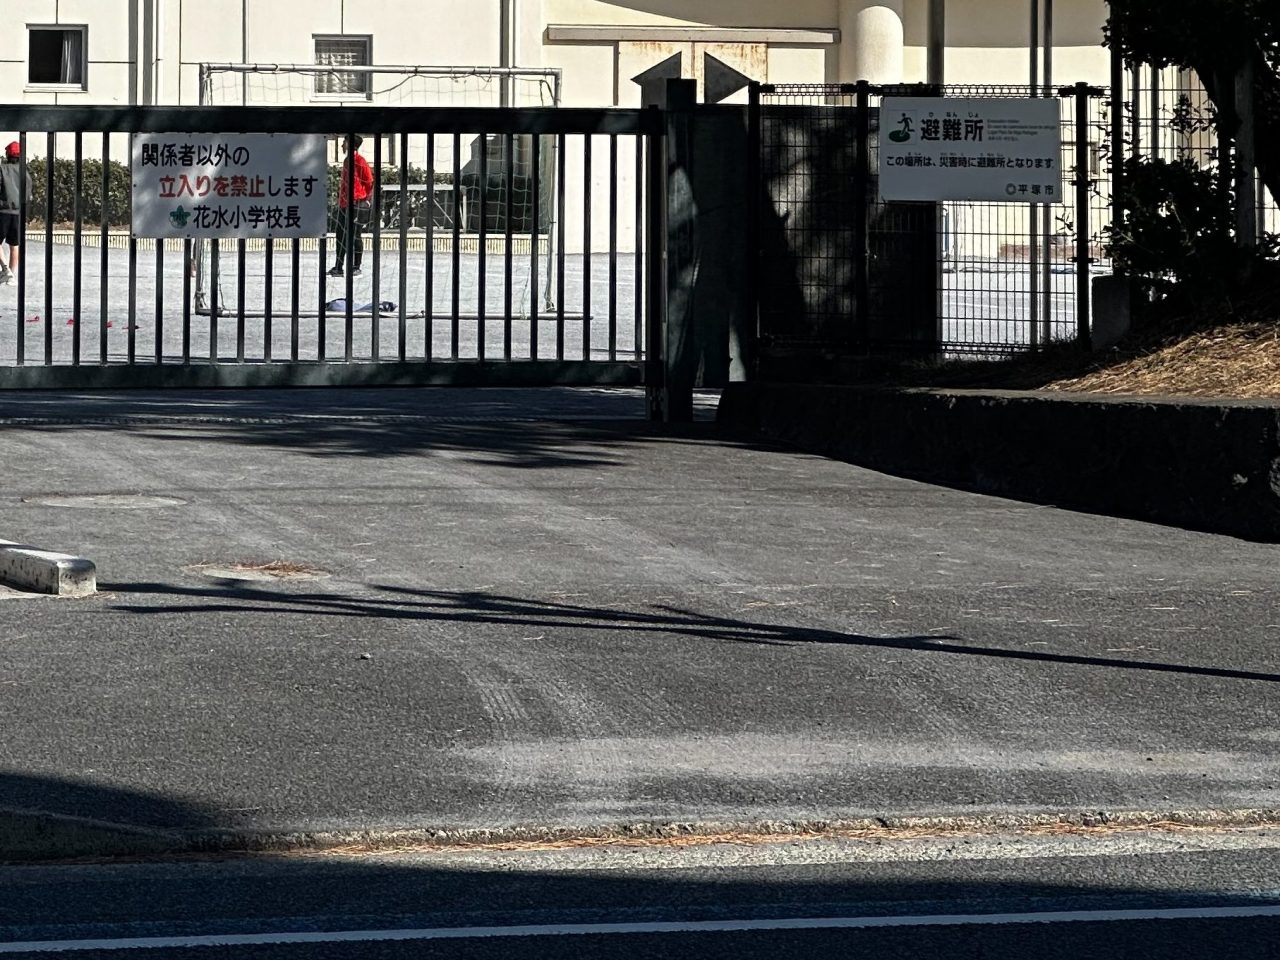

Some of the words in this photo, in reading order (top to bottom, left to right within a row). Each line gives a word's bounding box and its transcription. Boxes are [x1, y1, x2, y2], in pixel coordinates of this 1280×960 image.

[920, 118, 984, 142] 避難所
[141, 143, 250, 167] 関係者以外の
[159, 174, 318, 198] 立入りを禁止します
[1018, 184, 1054, 195] 平塚市
[193, 205, 301, 229] 花水小学校長
